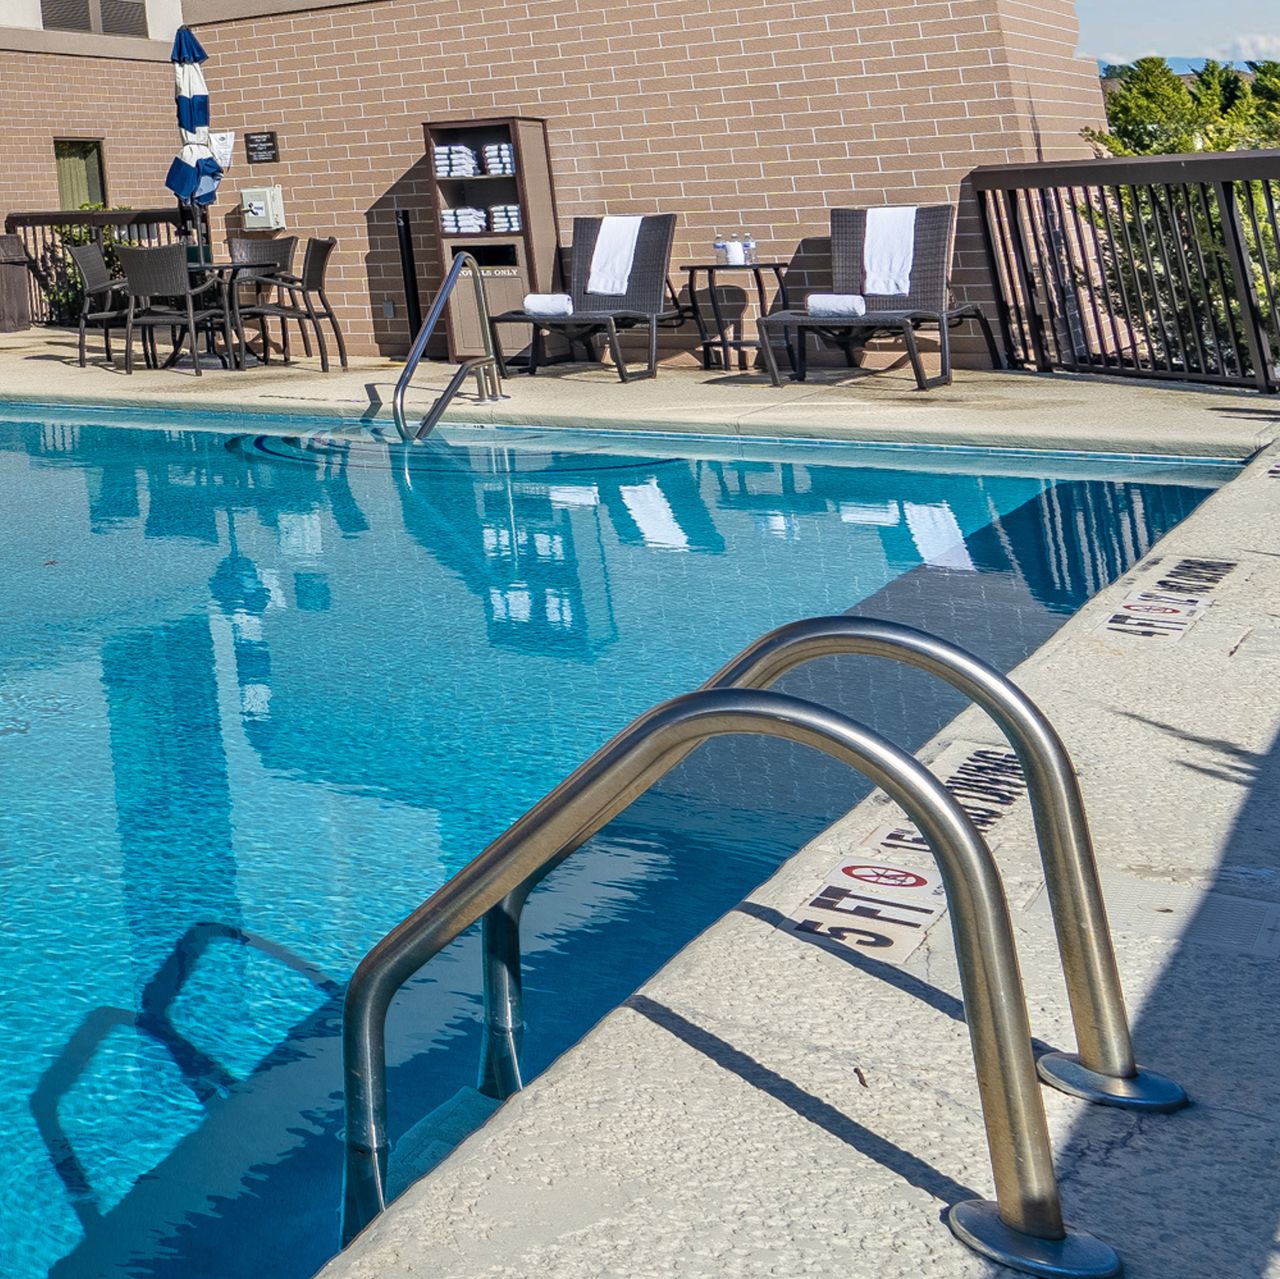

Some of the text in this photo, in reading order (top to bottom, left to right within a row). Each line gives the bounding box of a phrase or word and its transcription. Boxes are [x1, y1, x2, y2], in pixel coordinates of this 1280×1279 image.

[494, 269, 518, 277] ONLY
[809, 885, 936, 929] FT
[794, 919, 895, 948] 5
